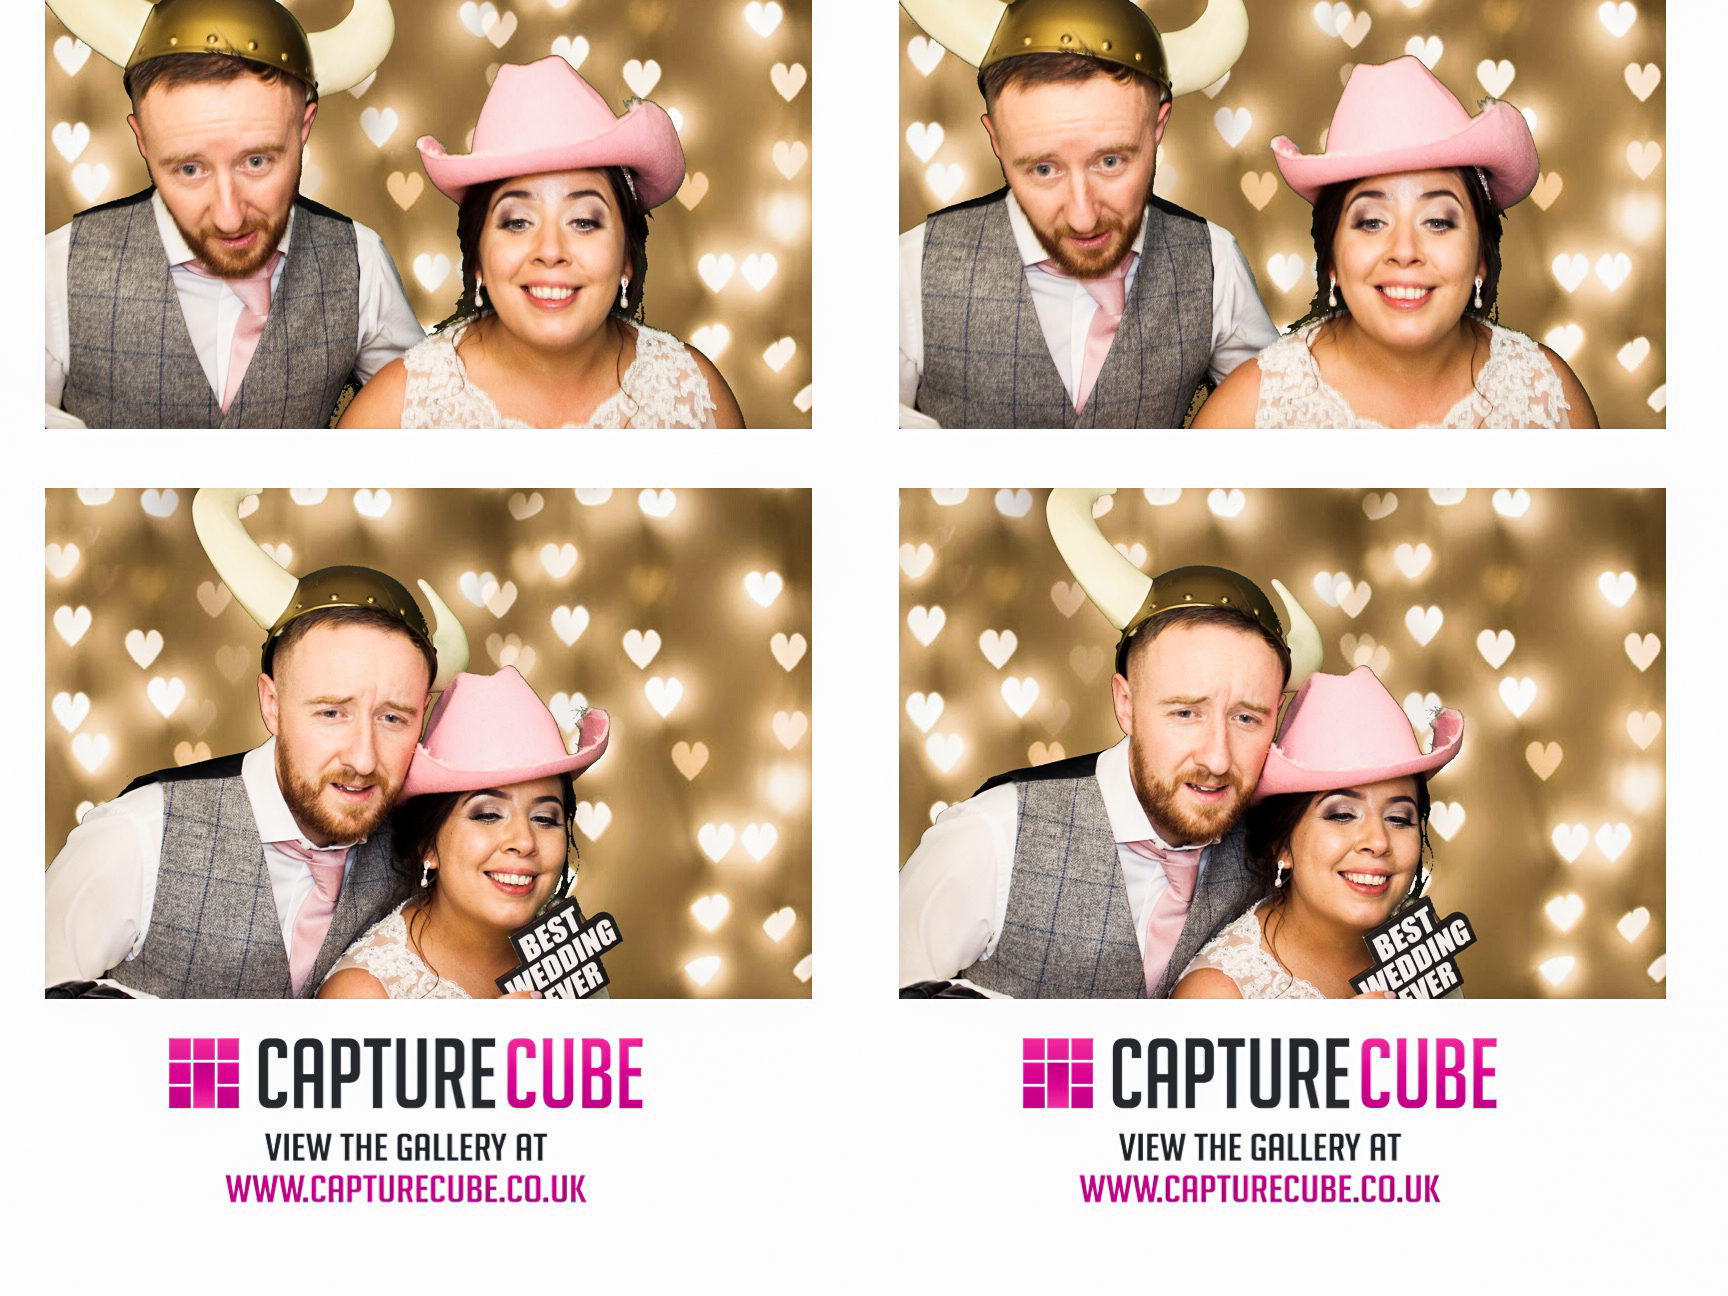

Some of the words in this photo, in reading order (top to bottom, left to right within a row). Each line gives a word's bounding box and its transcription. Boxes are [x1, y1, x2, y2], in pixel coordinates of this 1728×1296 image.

[503, 918, 618, 995] WEDDING
[517, 905, 580, 963] BEST
[1357, 918, 1472, 995] WEDDING
[1371, 905, 1434, 963] BEST
